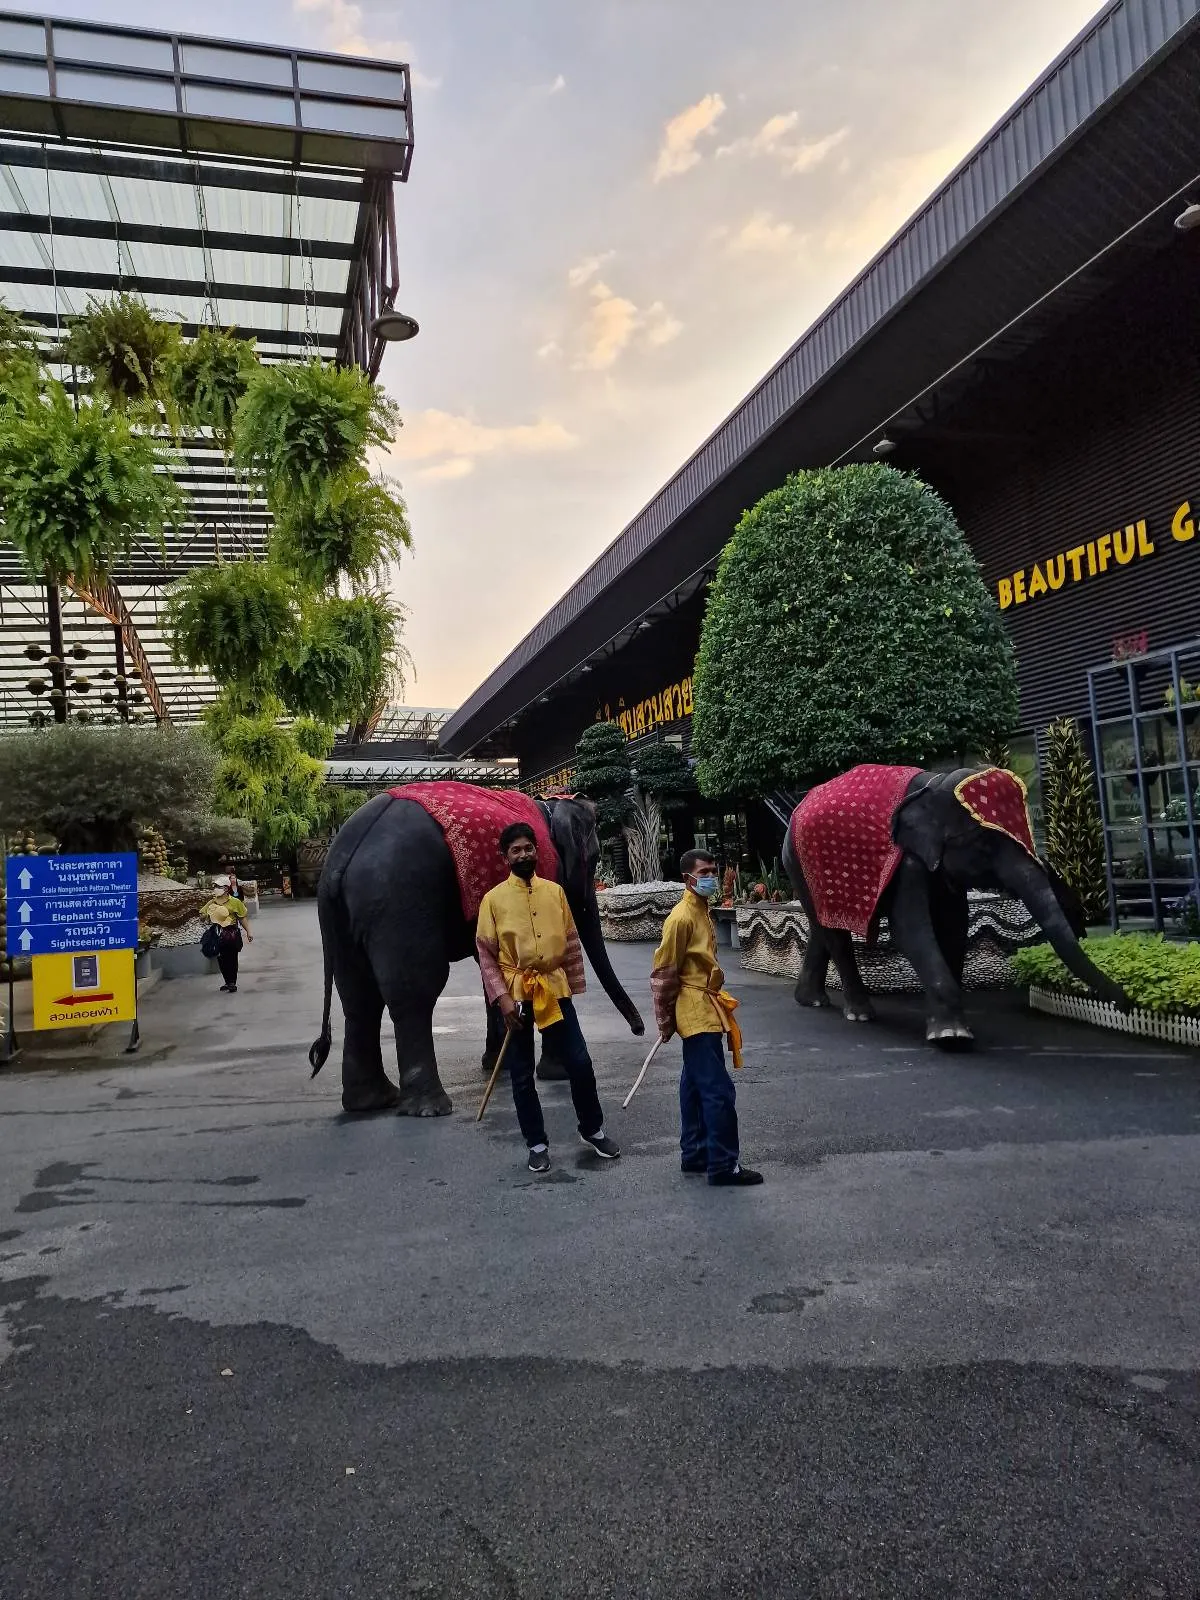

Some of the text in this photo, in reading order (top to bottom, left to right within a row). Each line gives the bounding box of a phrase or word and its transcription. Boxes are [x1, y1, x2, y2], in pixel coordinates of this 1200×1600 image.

[998, 500, 1200, 609] BEAUTIFUL G
[48, 860, 122, 871] โรงละครสกาลา
[58, 870, 115, 884] นงนุชพัทยา
[57, 885, 88, 894] Nongnooch
[89, 884, 110, 892] Pattaya
[111, 883, 131, 891] Theater
[45, 895, 127, 909] การแสดงช้างแสนรู้
[52, 911, 122, 922] Elephant Show
[64, 923, 111, 936] รถชมวิว
[51, 936, 126, 949] Sightseeing Bus
